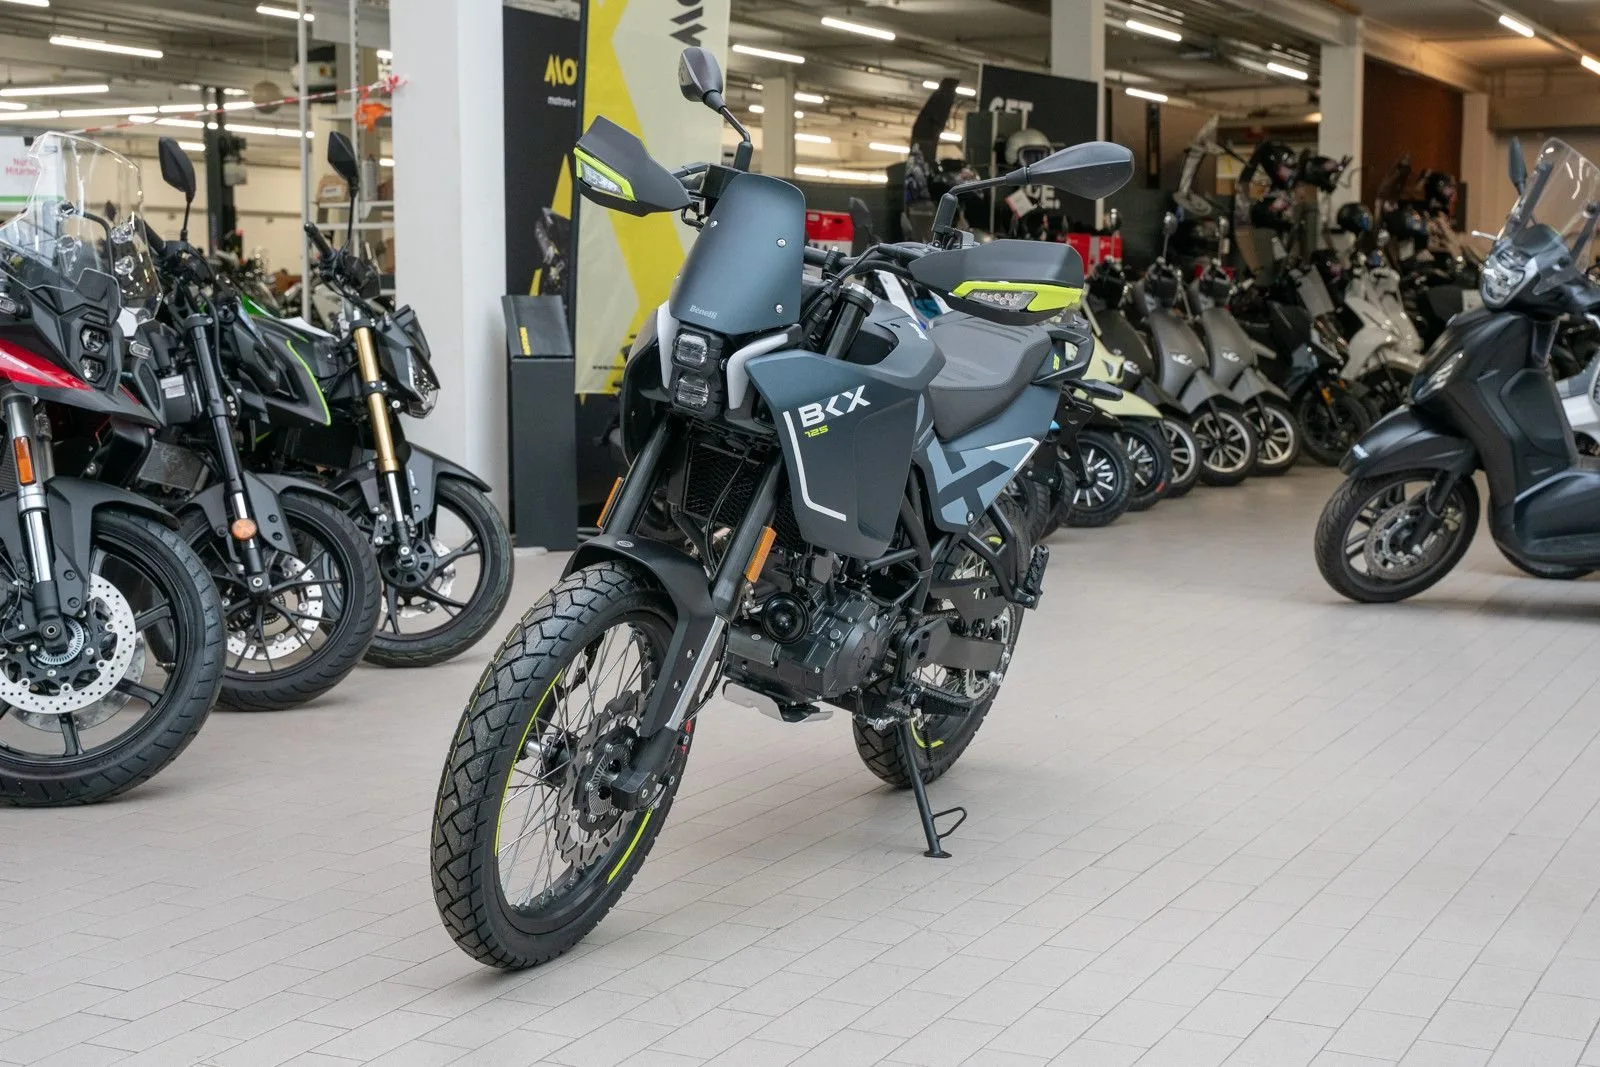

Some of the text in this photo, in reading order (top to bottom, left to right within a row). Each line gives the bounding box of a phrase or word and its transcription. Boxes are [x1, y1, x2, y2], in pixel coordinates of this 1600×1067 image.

[544, 53, 578, 87] MO
[690, 304, 718, 320] Benelli
[804, 425, 829, 438] 125
